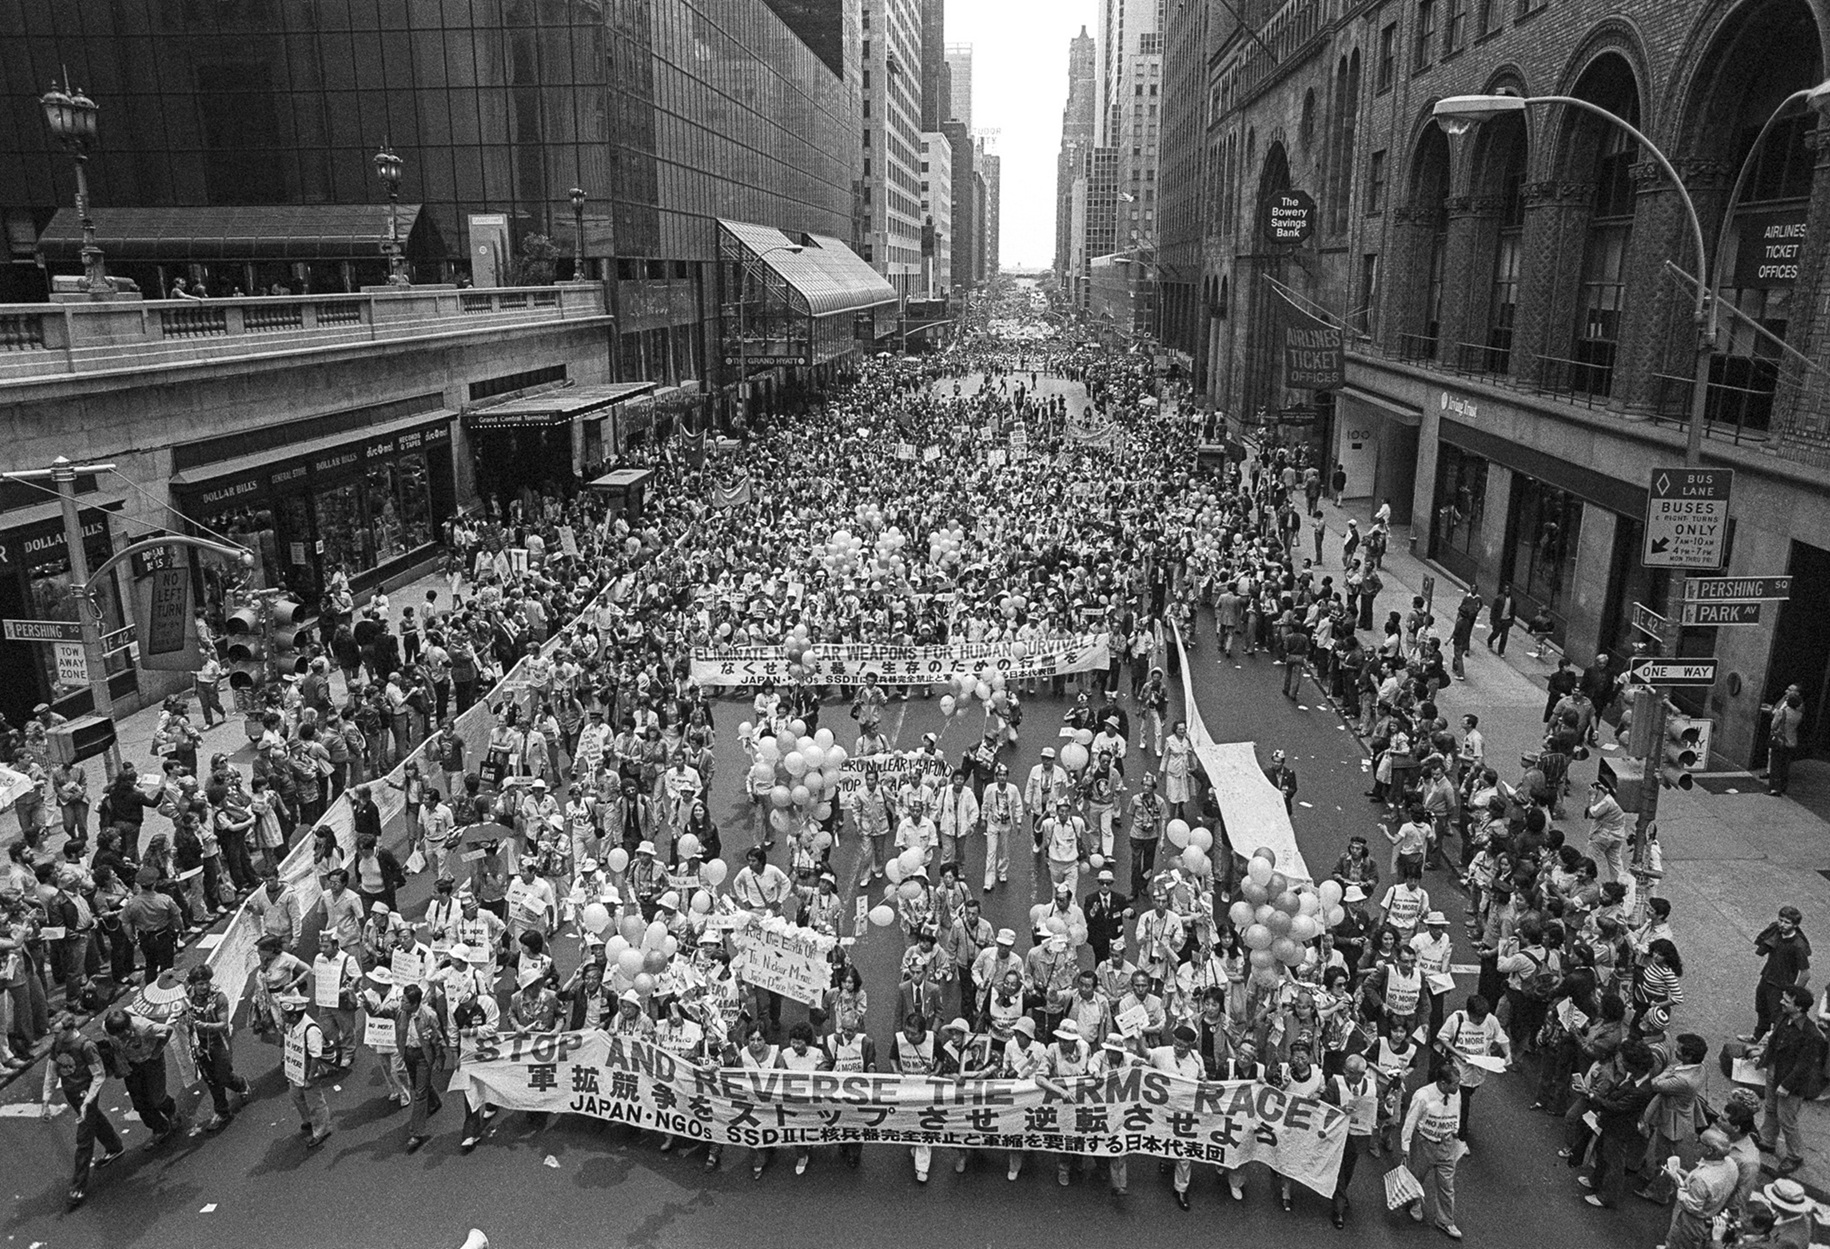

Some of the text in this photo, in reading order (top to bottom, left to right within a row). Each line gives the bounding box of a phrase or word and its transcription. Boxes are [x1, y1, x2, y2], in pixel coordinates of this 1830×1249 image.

[972, 127, 1002, 136] TUDOR
[1281, 196, 1299, 206] The
[1272, 207, 1308, 218] Bowery
[1271, 218, 1307, 229] Savings
[1276, 228, 1300, 237] Bank
[1764, 223, 1807, 238] AIRLINES
[1766, 244, 1799, 258] TICKET
[1758, 264, 1798, 278] OFFICES
[1286, 328, 1340, 348] AIRLINES
[747, 357, 775, 365] GRAND
[776, 357, 798, 365] HYATT
[1290, 350, 1338, 369] TICKET
[1291, 370, 1340, 382] OFFICES
[524, 413, 550, 422] Terminal
[1347, 430, 1370, 440] 100
[316, 457, 340, 472] DOLLAR
[271, 466, 308, 484] GENERAL STORE
[1688, 475, 1713, 484] BUS
[203, 486, 236, 504] DOLLAR
[1682, 487, 1714, 496] LANE
[1662, 502, 1714, 514] BUSES
[1675, 524, 1717, 536] ONLY
[163, 572, 178, 586] NO
[1701, 580, 1788, 597] PERSHING SQ
[158, 588, 182, 602] LEFT
[158, 604, 182, 618] TURN
[1700, 606, 1757, 622] PARK AV
[1640, 611, 1646, 626] E
[1647, 619, 1658, 633] 42
[16, 624, 62, 638] PERSHING
[108, 638, 114, 650] E
[118, 631, 129, 645] 42
[61, 646, 79, 656] TOW
[695, 647, 768, 662] ELIMINATE
[848, 645, 917, 661] WEAPONS
[923, 646, 953, 660] FOR
[960, 643, 1012, 660] HUMAN
[60, 658, 84, 668] AWAY
[61, 670, 86, 680] ZONE
[1642, 667, 1710, 677] ONE WAY
[842, 1062, 862, 1072] MORE
[475, 1033, 1342, 1139] STOP AND REVERSE THE ARMS RACE!
[1425, 1119, 1458, 1130] NO MORE
